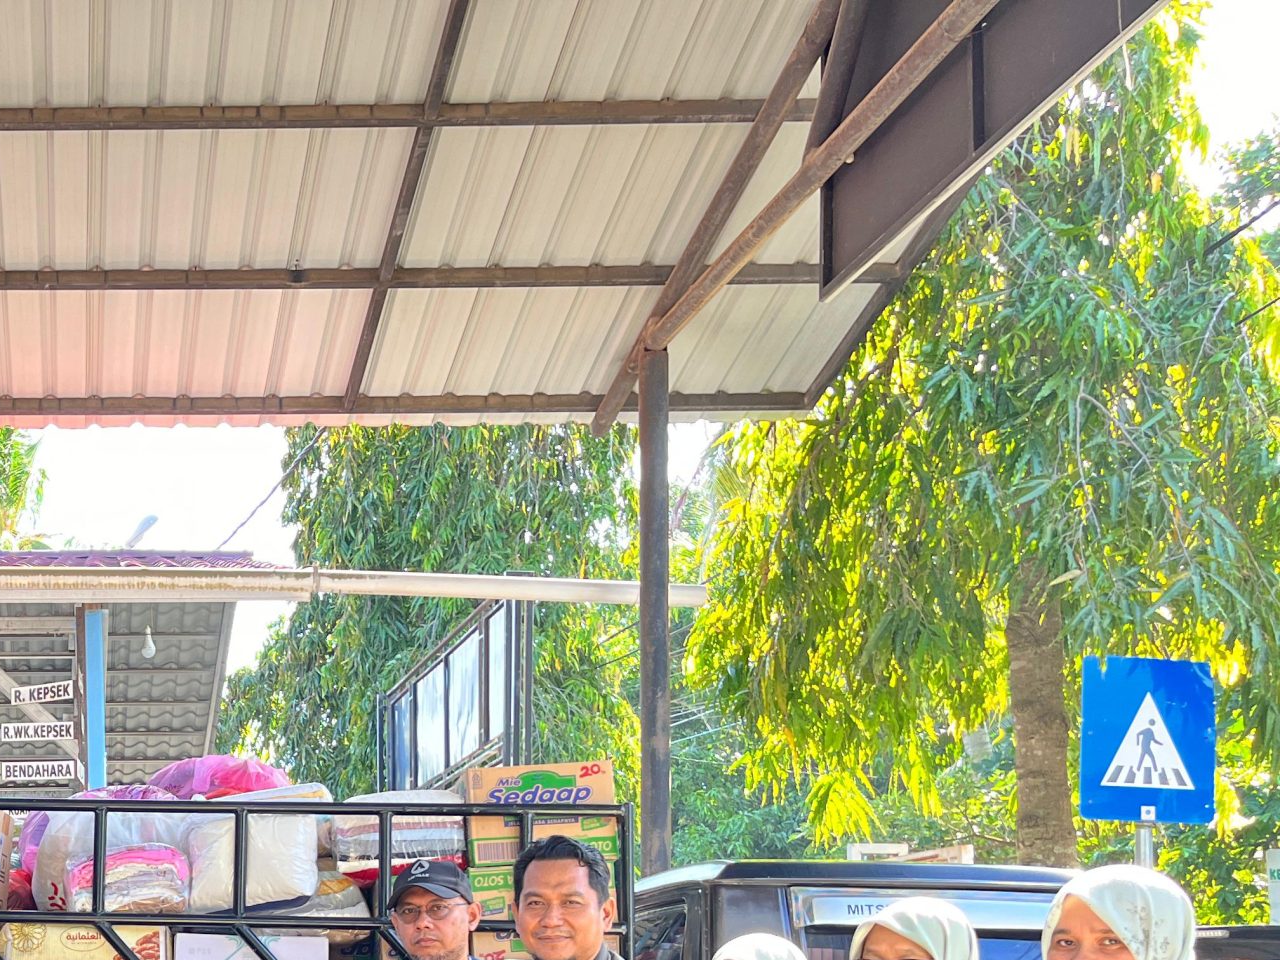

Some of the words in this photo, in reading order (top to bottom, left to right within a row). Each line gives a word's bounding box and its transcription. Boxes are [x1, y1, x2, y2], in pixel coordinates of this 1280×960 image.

[14, 689, 25, 703] R.
[29, 683, 71, 702] KEPSEK
[3, 724, 72, 739] R.WK.KEPSEK
[5, 764, 72, 778] BENDAHARA
[579, 764, 601, 778] 20
[497, 777, 521, 786] Mie
[488, 785, 591, 804] Sedaap
[475, 875, 504, 888] SOTO
[847, 904, 888, 916] MITS
